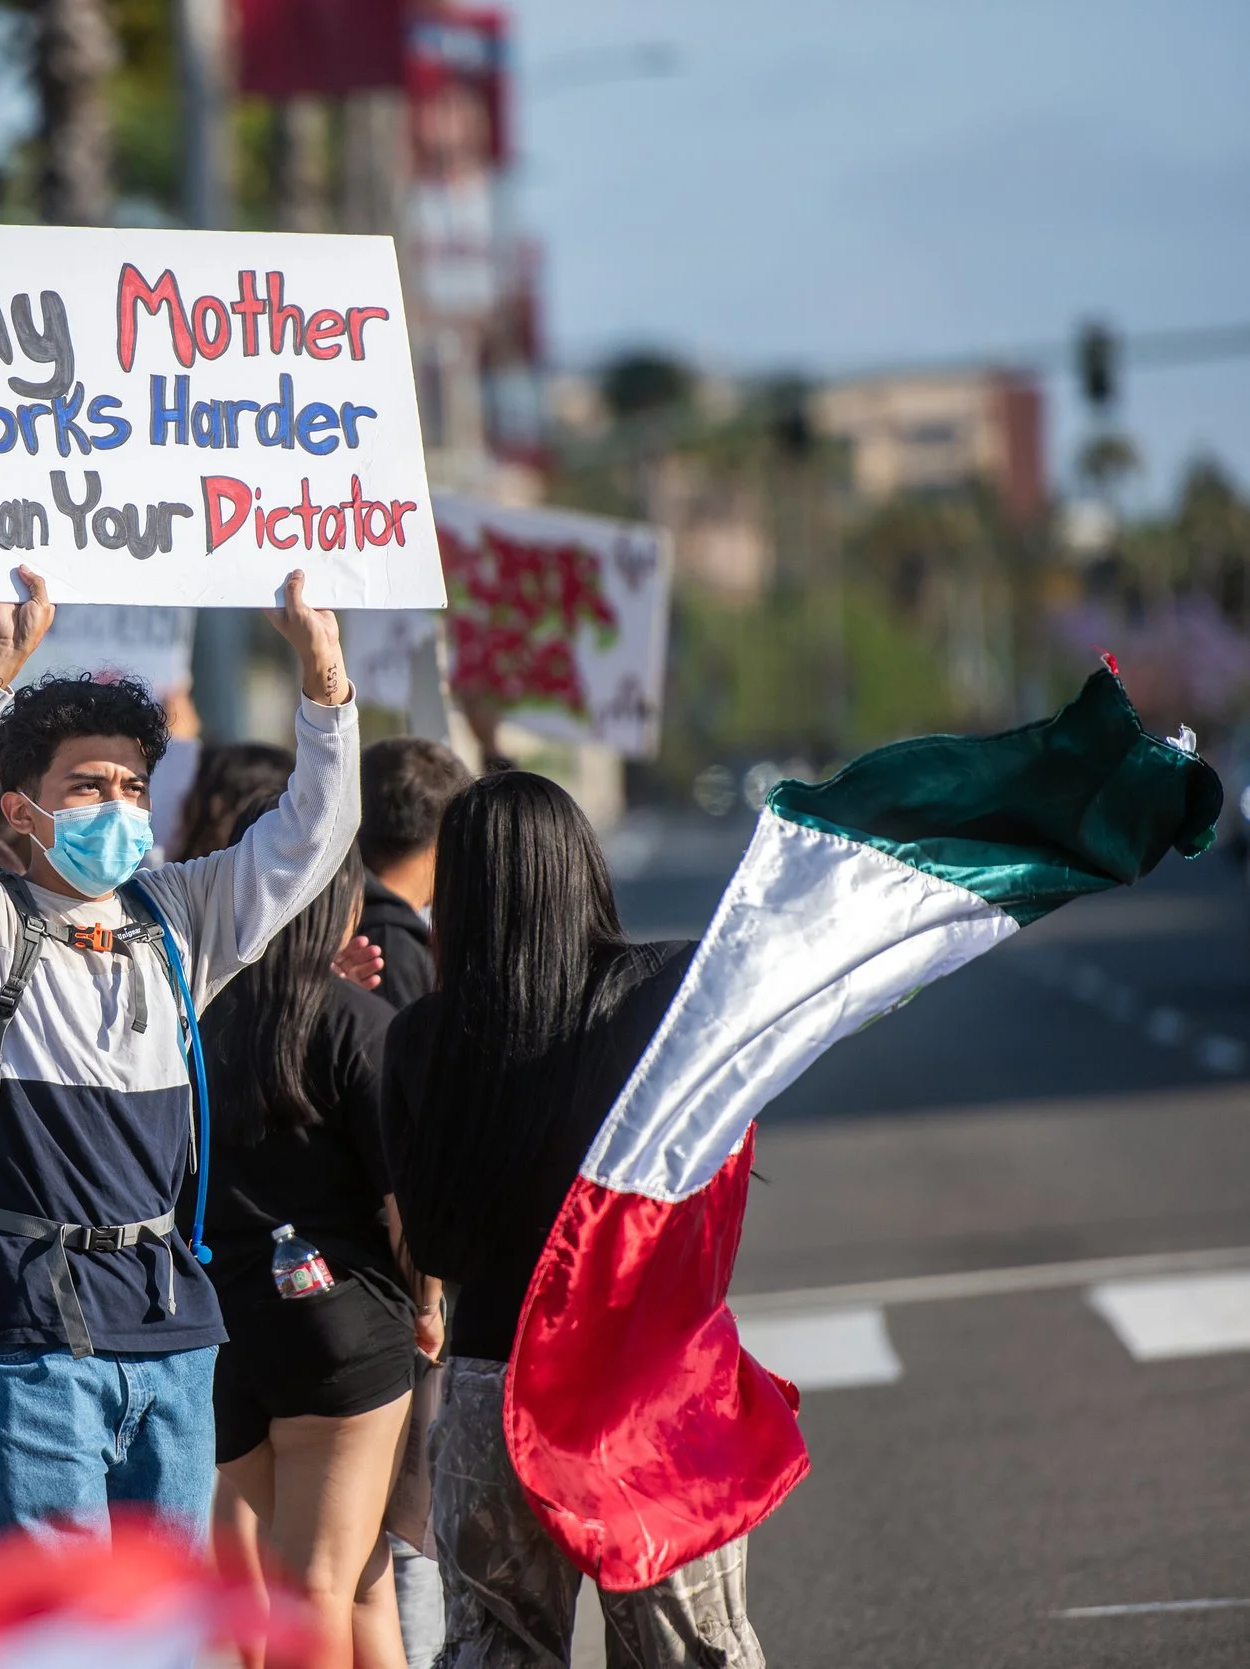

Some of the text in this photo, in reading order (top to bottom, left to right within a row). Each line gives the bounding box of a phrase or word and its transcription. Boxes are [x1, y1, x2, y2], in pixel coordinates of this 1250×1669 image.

[117, 262, 390, 373] Mother
[149, 373, 378, 456] Harder
[50, 470, 194, 560] Your
[201, 474, 418, 555] Dictator
[116, 927, 142, 941] Unigear
